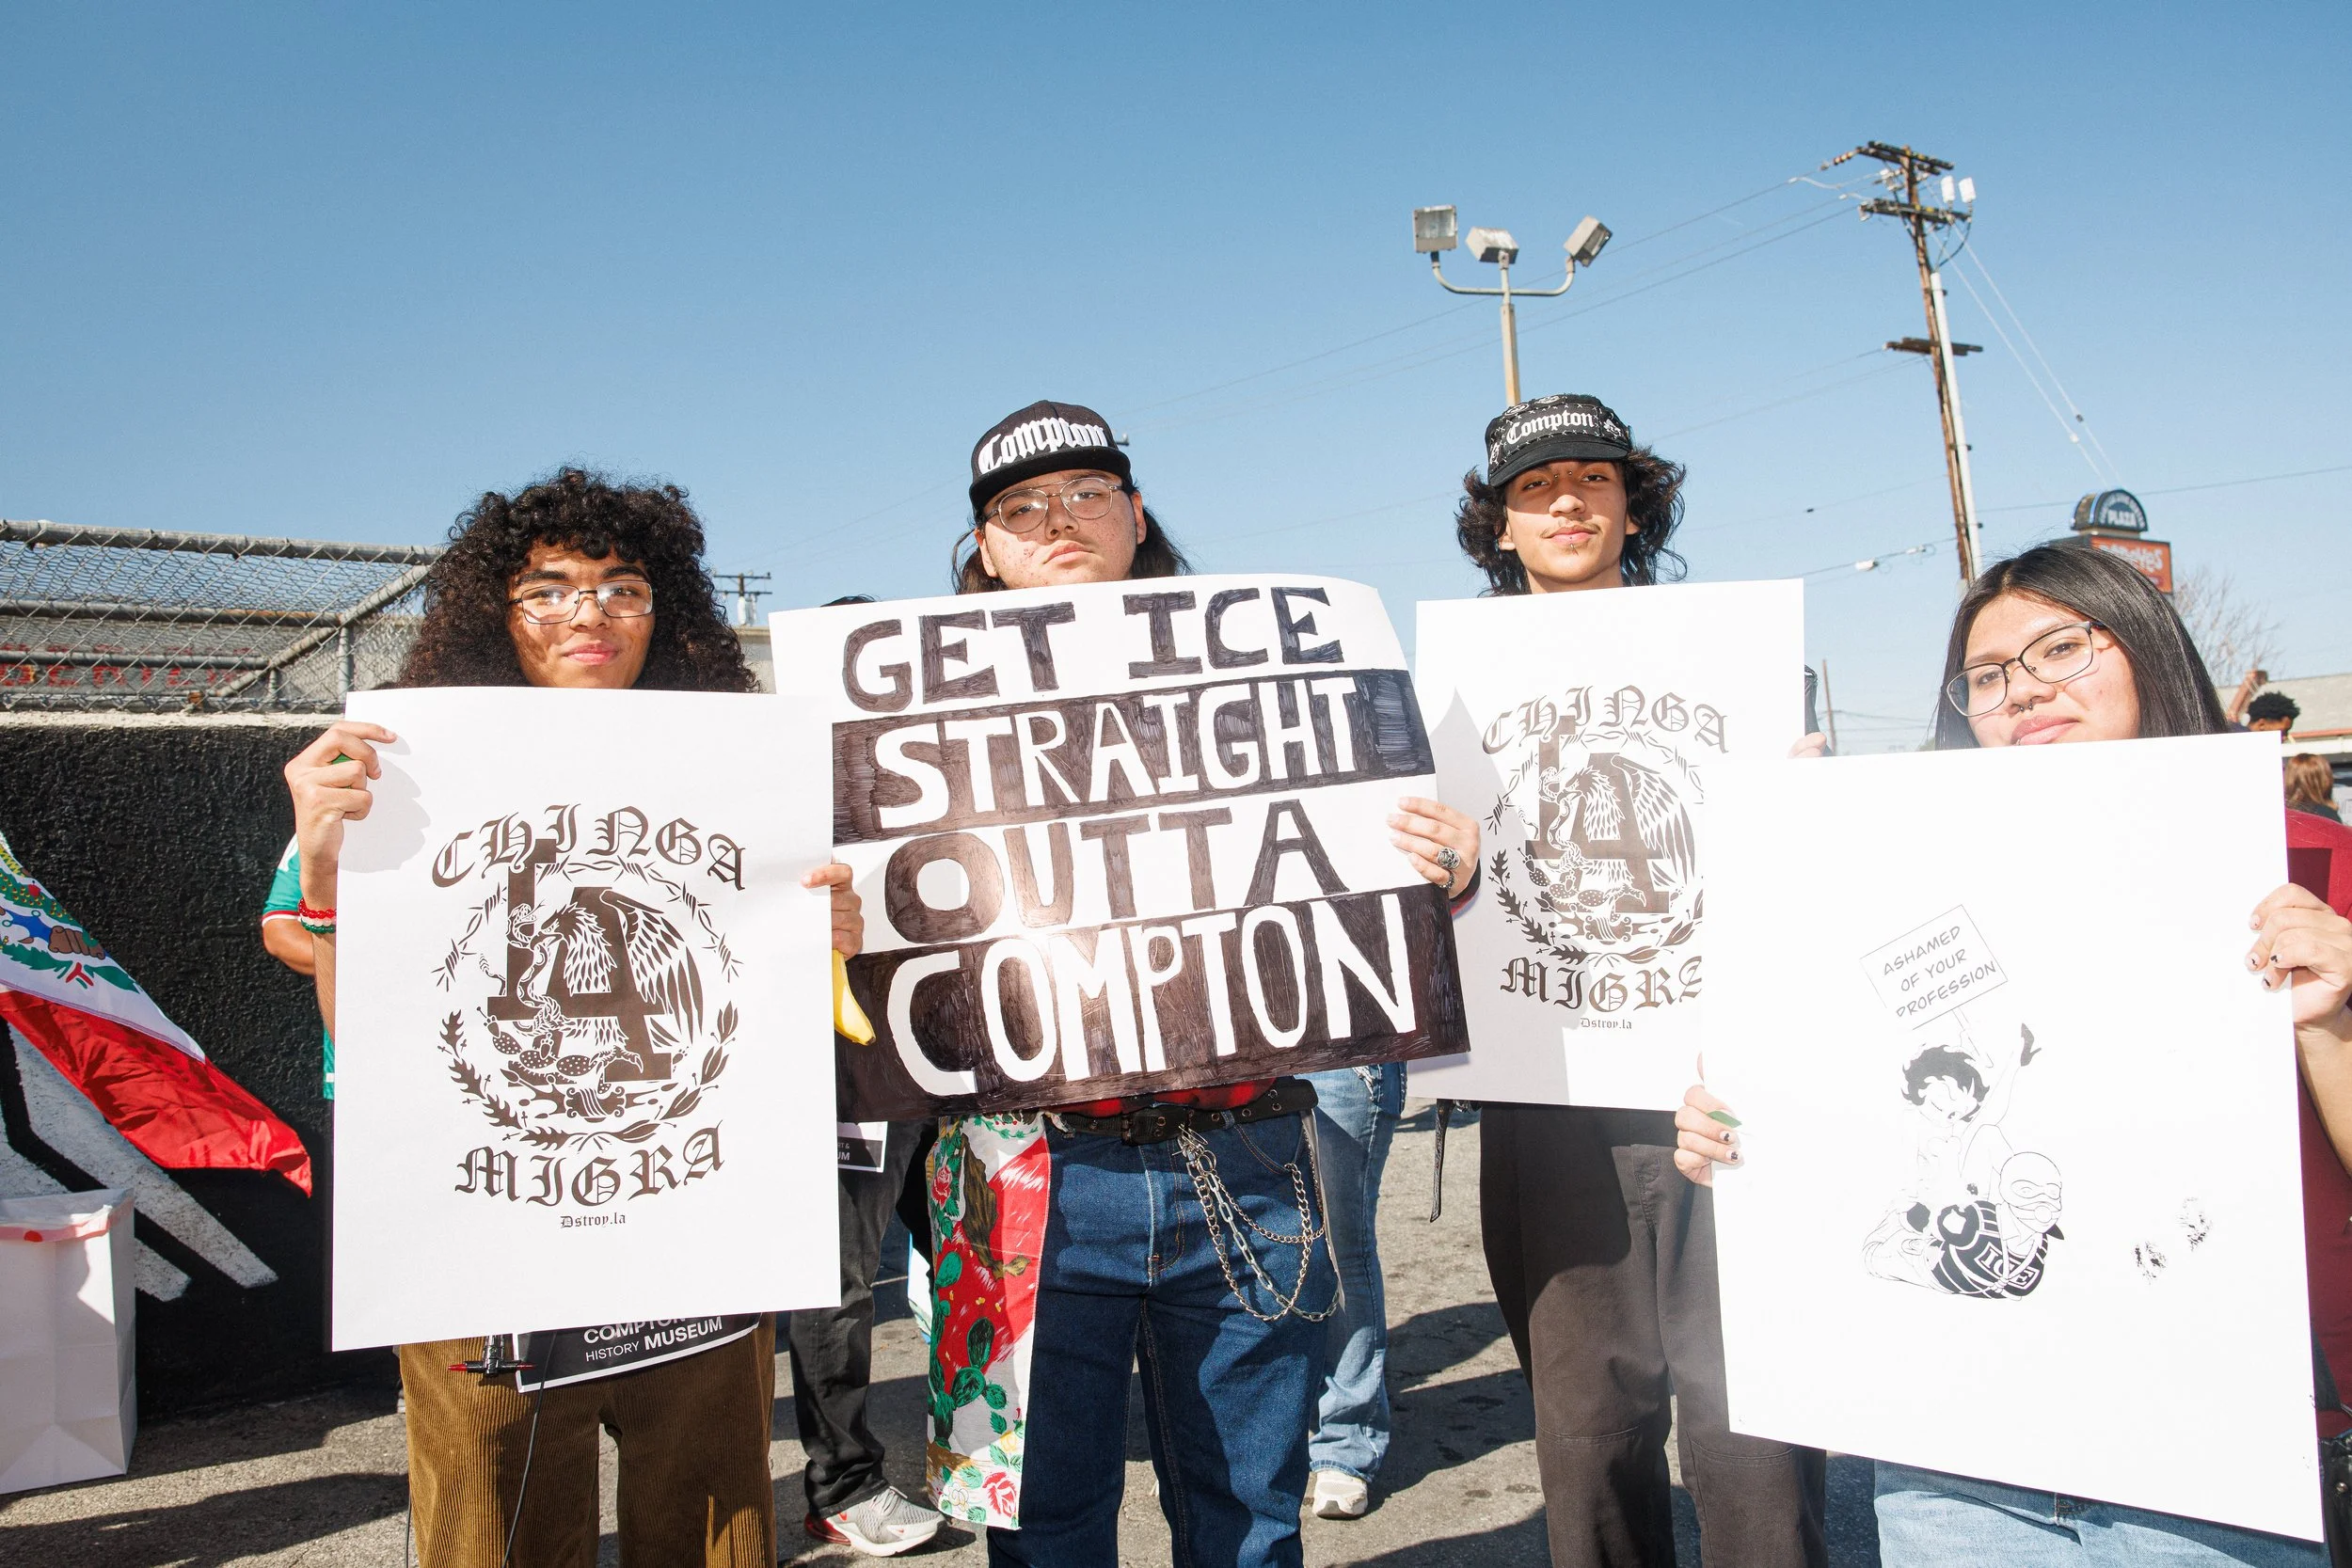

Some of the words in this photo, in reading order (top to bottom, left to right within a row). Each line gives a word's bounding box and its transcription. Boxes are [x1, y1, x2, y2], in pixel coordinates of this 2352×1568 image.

[978, 417, 1108, 475] Compton
[1506, 410, 1595, 445] Compton
[843, 602, 1076, 712] GET
[1123, 587, 1344, 678] ICE
[1483, 685, 1729, 754] CHINGA
[874, 677, 1359, 831] STRAIGHT
[432, 803, 746, 892] CHINGA
[884, 800, 1350, 944] OUTTA
[1883, 926, 1961, 976] ASHAMED
[1900, 972, 1920, 991] OF
[1925, 948, 1967, 979] YOUR
[887, 894, 1418, 1097] COMPTON
[1896, 960, 1996, 1018] PROFESSION
[454, 1119, 725, 1208] MIGRA
[560, 1212, 627, 1229] Dstroy.la
[585, 1341, 640, 1362] HISTORY
[644, 1317, 723, 1351] MUSEUM
